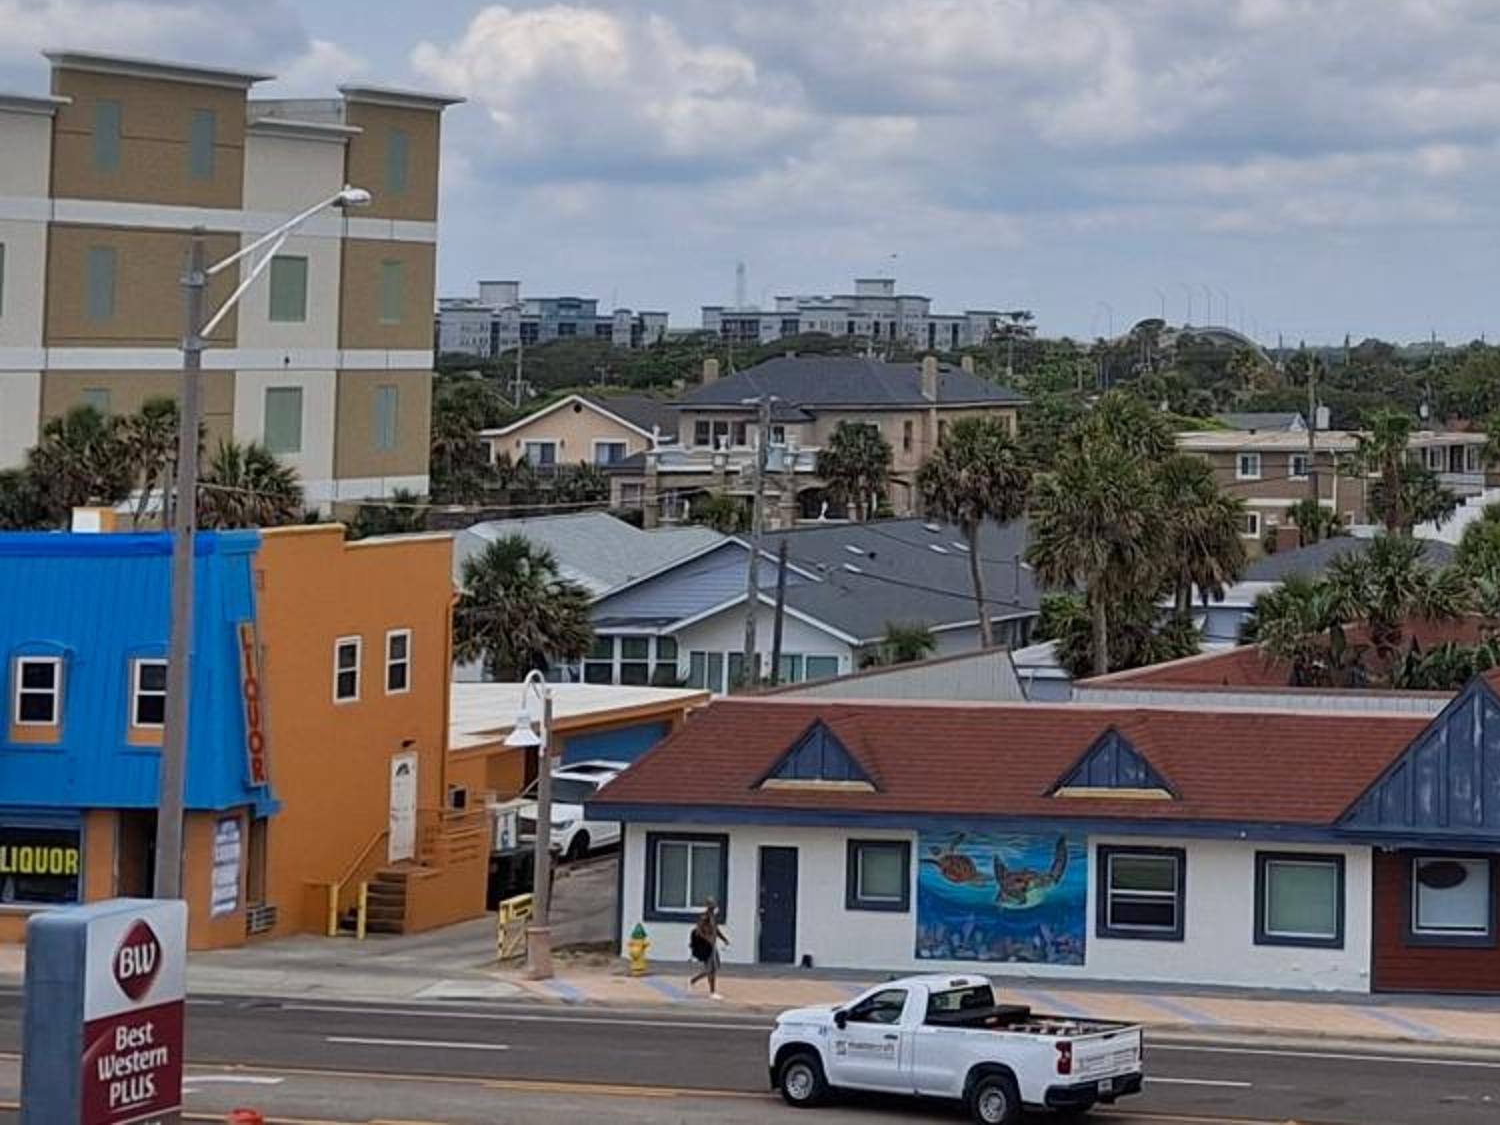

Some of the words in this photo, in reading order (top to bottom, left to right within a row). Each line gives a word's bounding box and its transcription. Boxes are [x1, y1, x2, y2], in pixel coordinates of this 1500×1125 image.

[241, 625, 265, 783] LIQUOR
[0, 846, 79, 874] LIQUOR
[119, 941, 156, 980] BW
[115, 1022, 154, 1051] Best
[98, 1046, 168, 1082] Western
[109, 1072, 156, 1108] PLUS
